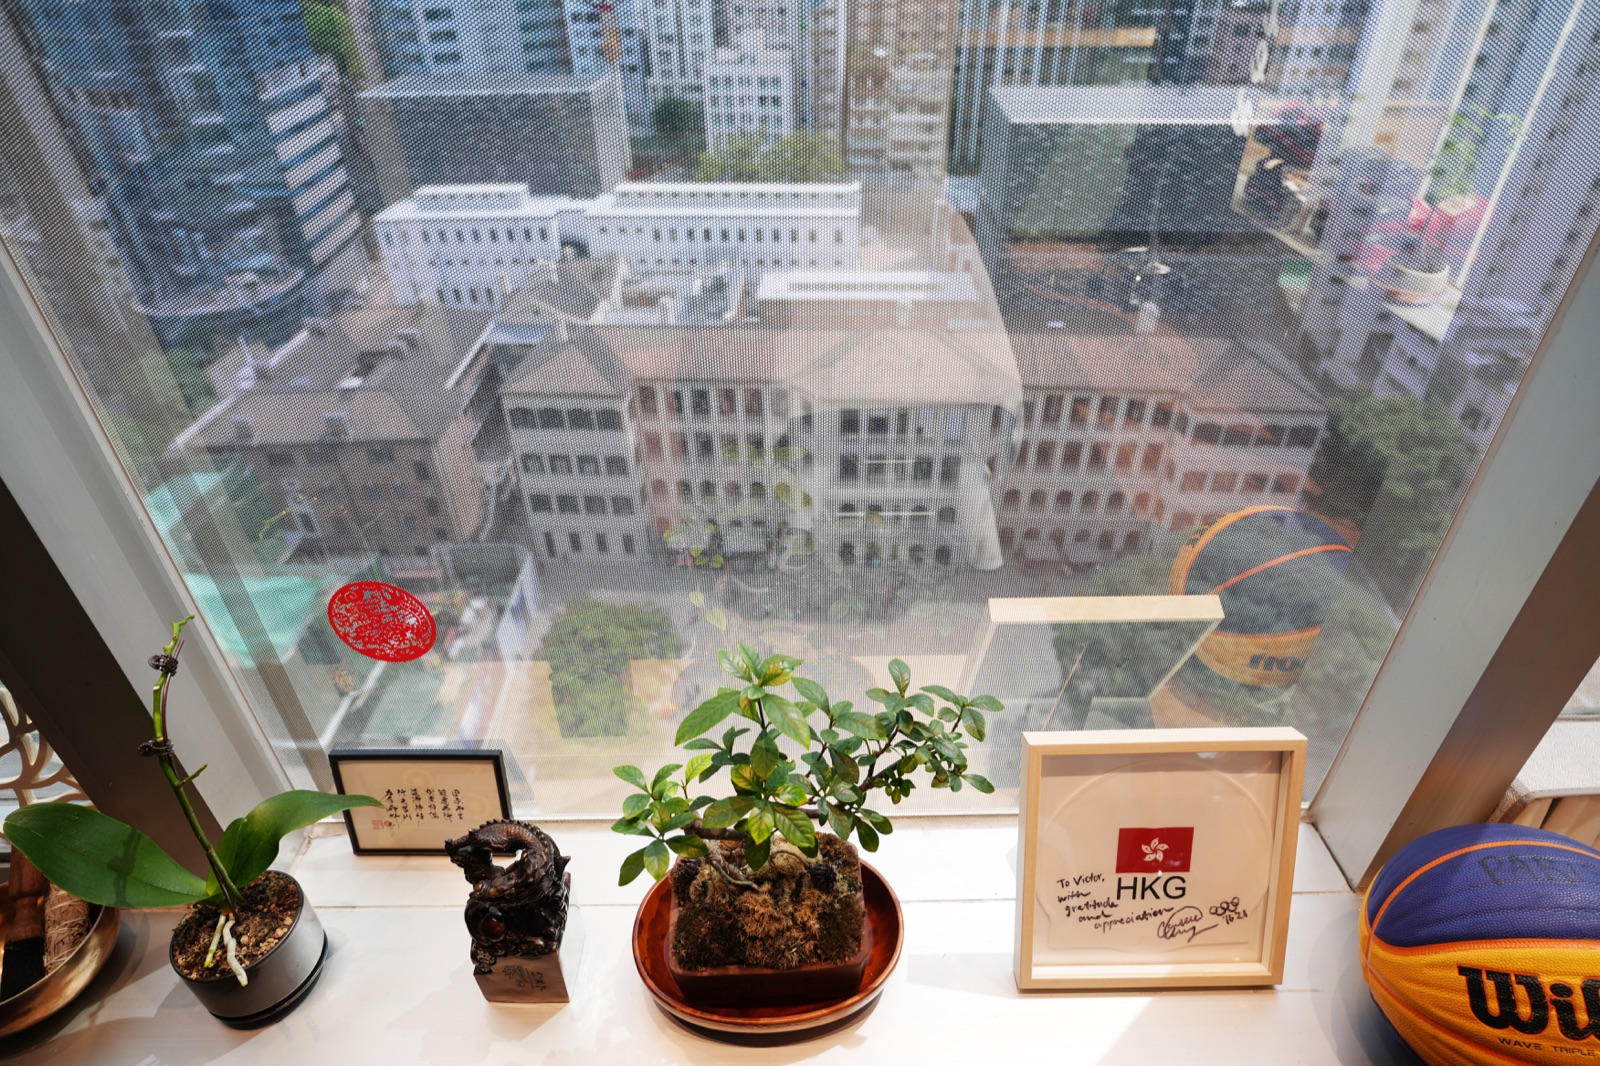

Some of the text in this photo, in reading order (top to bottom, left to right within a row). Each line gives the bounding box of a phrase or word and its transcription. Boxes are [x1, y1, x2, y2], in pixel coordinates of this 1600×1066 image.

[1056, 873, 1105, 888] To Victor,
[1116, 875, 1187, 901] HKG
[1057, 890, 1091, 903] with
[1065, 897, 1119, 917] gratitude
[1078, 910, 1112, 922] and
[1094, 906, 1175, 933] appreciation
[1497, 1037, 1597, 1057] WAVE TRIPLE
